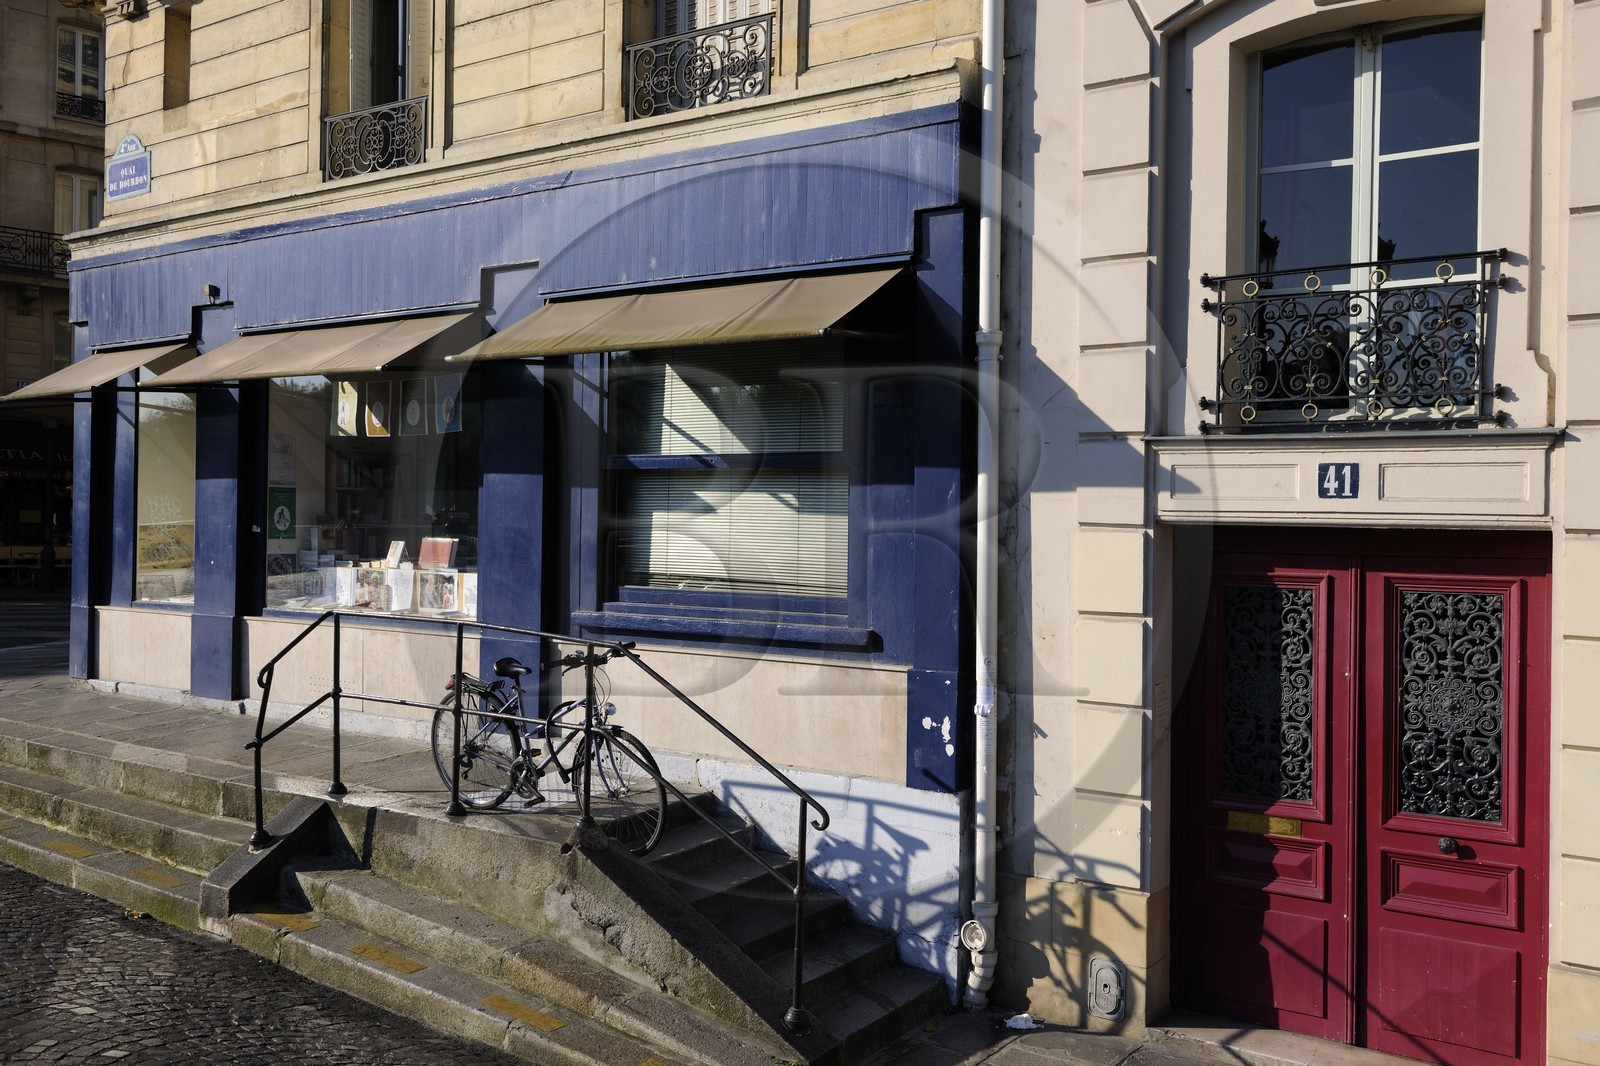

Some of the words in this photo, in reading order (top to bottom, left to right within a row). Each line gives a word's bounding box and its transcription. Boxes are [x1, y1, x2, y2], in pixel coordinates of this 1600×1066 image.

[120, 165, 136, 178] QUAI
[109, 182, 118, 192] DE
[120, 175, 147, 189] BOURBON
[26, 471, 62, 480] Sorbts
[1323, 465, 1353, 496] 41
